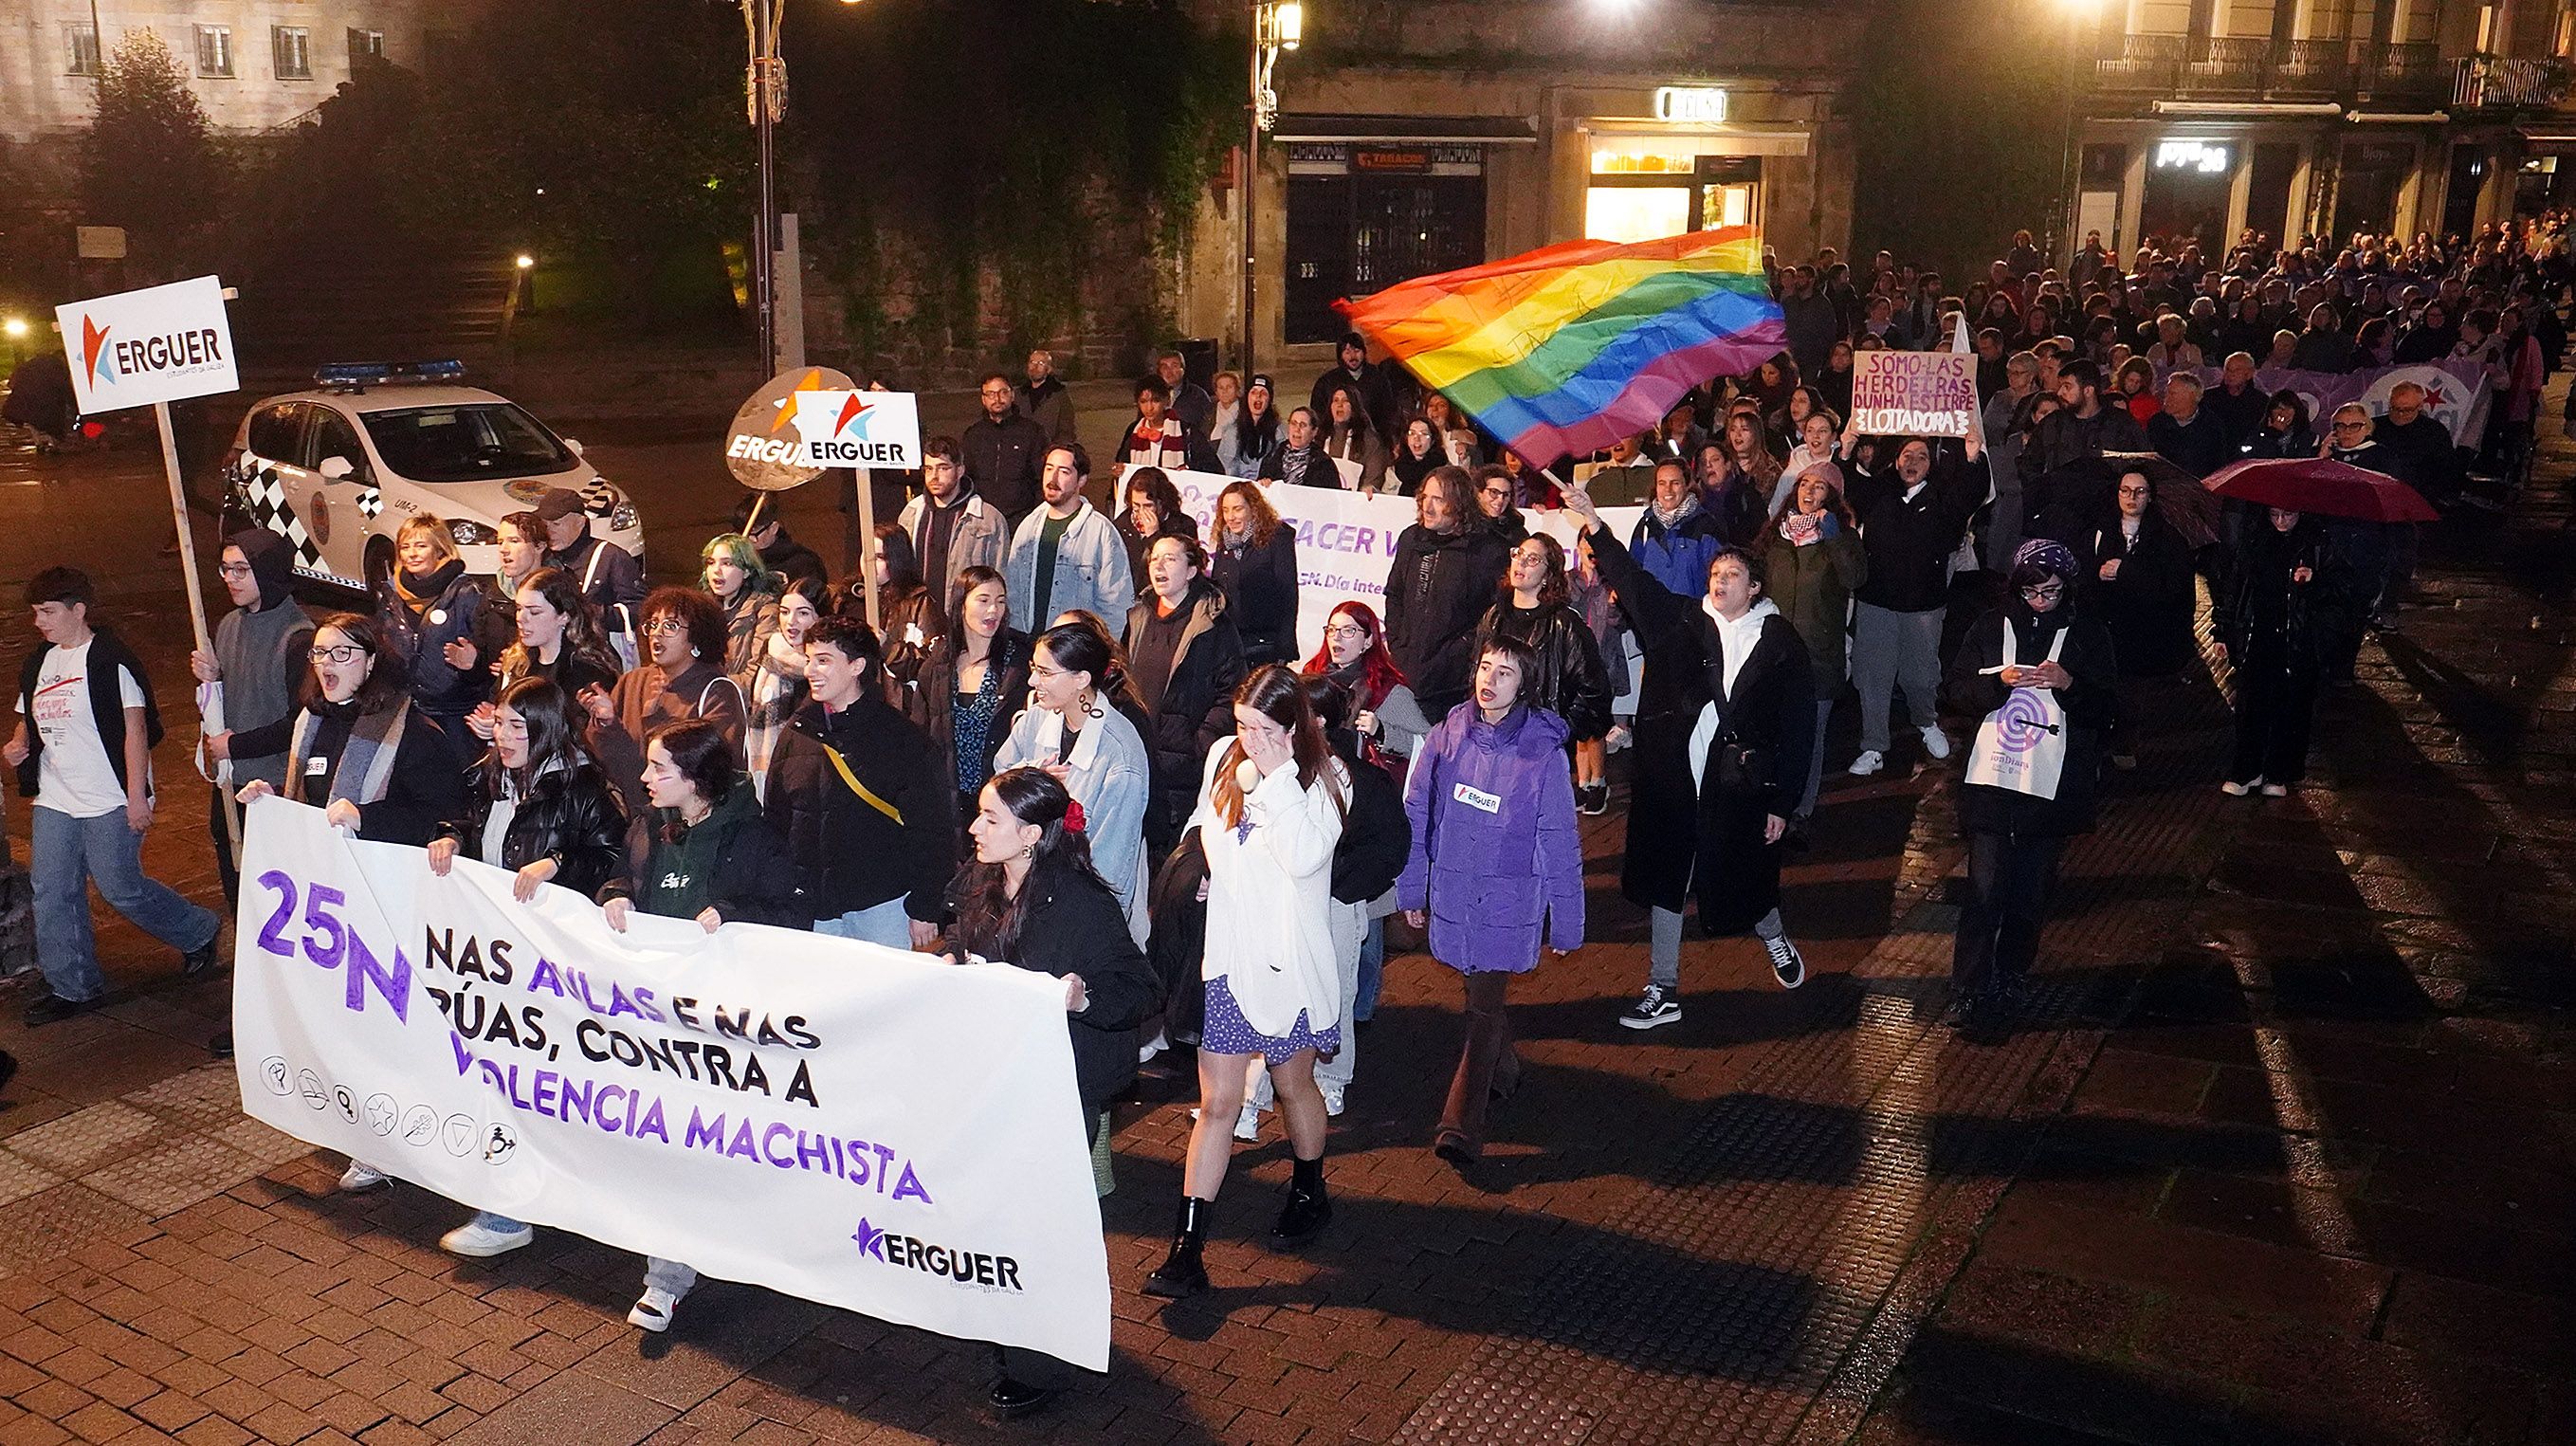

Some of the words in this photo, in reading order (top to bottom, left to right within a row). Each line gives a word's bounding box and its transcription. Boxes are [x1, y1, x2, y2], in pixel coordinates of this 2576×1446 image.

[116, 328, 222, 375] ERGUER
[1854, 375, 1971, 394] HERDEIRAS
[1854, 394, 1906, 410] DUNHA
[1909, 394, 1974, 412] ESTIRPE
[1868, 409, 1955, 434] LOITADORA
[727, 434, 827, 470] ERGU
[811, 441, 904, 462] ERGUER
[394, 499, 418, 513] UM-2
[1325, 574, 1350, 591] Día
[257, 869, 412, 1026] 25N
[426, 923, 512, 985] NAS
[527, 957, 667, 1024] AULAS
[672, 995, 709, 1034] E
[714, 1004, 822, 1050] NAS
[575, 1017, 771, 1098] CONTRA
[785, 1057, 820, 1108] A
[684, 1104, 934, 1205] MACHISTA
[883, 1233, 1023, 1290] ERGUER
